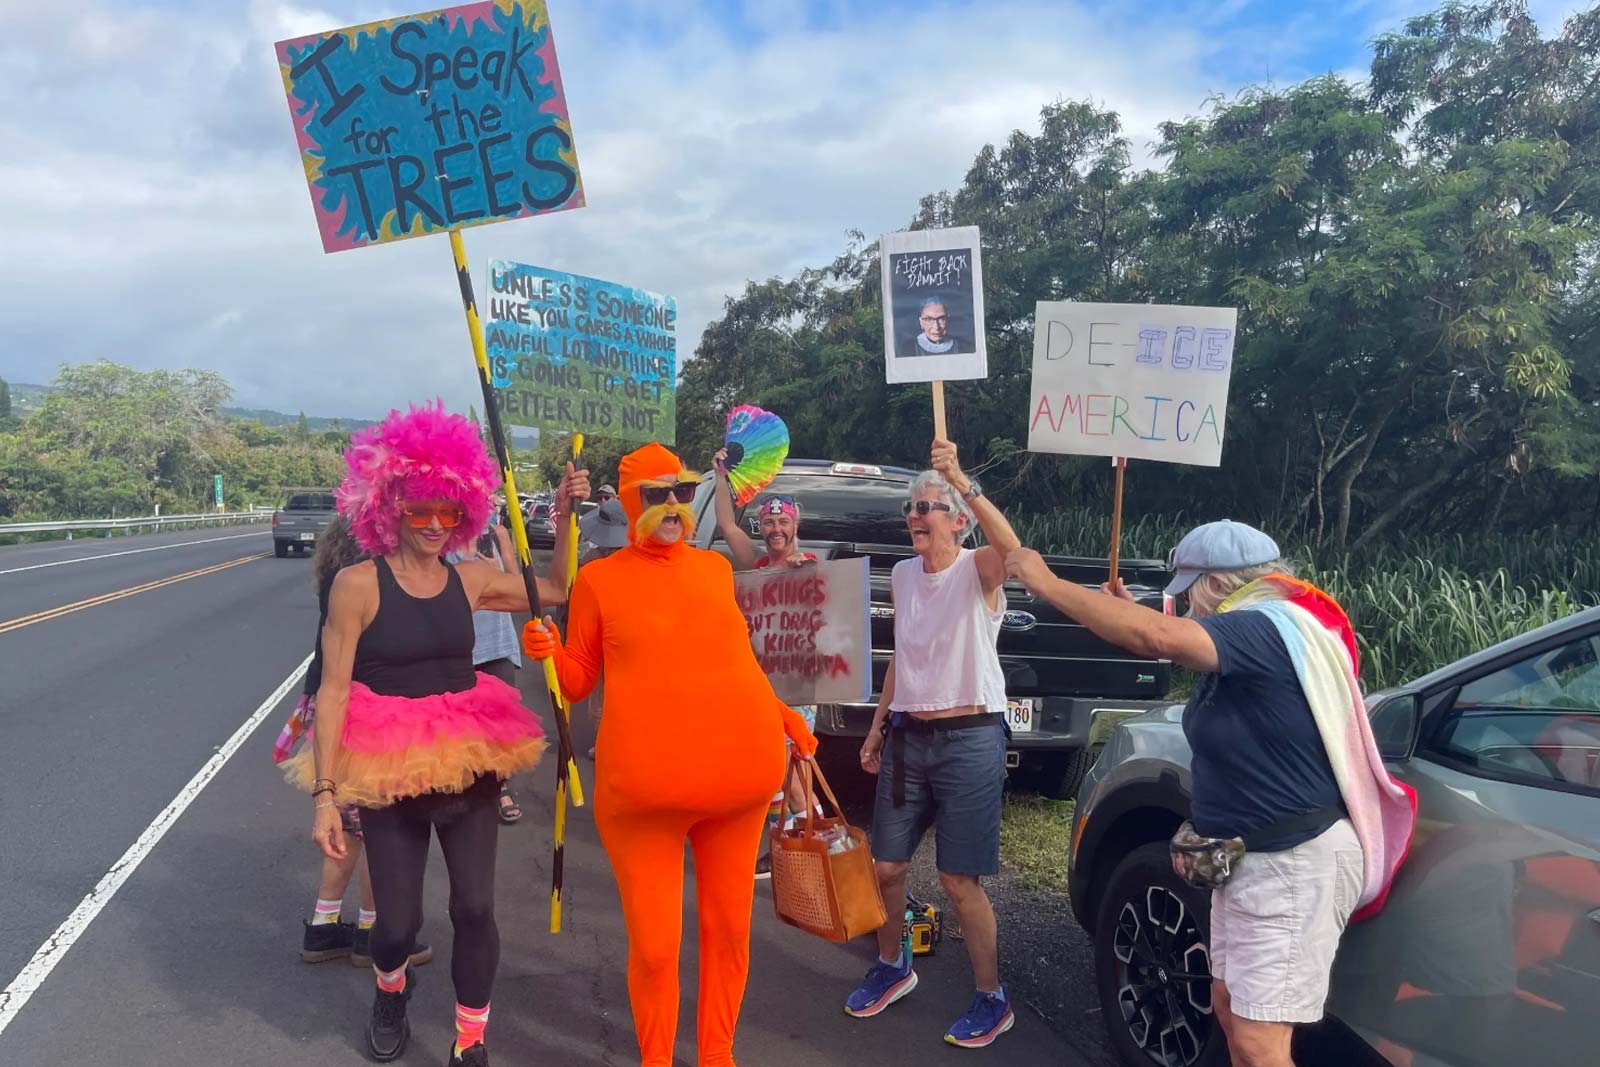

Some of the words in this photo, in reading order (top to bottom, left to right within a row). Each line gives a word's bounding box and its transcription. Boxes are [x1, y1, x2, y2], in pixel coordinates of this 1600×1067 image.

[289, 32, 366, 127] I
[379, 22, 535, 106] Speak
[343, 117, 398, 154] for
[424, 93, 502, 145] the
[327, 126, 577, 241] TREES
[895, 254, 933, 274] FIGHT
[938, 254, 967, 272] BACK
[491, 267, 588, 311] UNLESS
[595, 290, 676, 331] SOMEONE
[491, 297, 531, 325] LIKE
[535, 306, 570, 328] YOU
[575, 314, 622, 341] CARES
[624, 326, 634, 344] A
[635, 328, 676, 352] WHOLE
[487, 328, 553, 356] AWFUL
[562, 336, 591, 361] LOT
[596, 343, 670, 379] NOTHING
[489, 355, 507, 379] IS
[517, 358, 582, 389] GOING
[590, 371, 615, 394] TO
[625, 376, 664, 404] GET
[622, 405, 660, 433] NOT
[1030, 393, 1221, 446] AMERICA
[762, 578, 826, 607] KINGS
[763, 631, 817, 654] KINGS
[780, 610, 827, 632] DRAG
